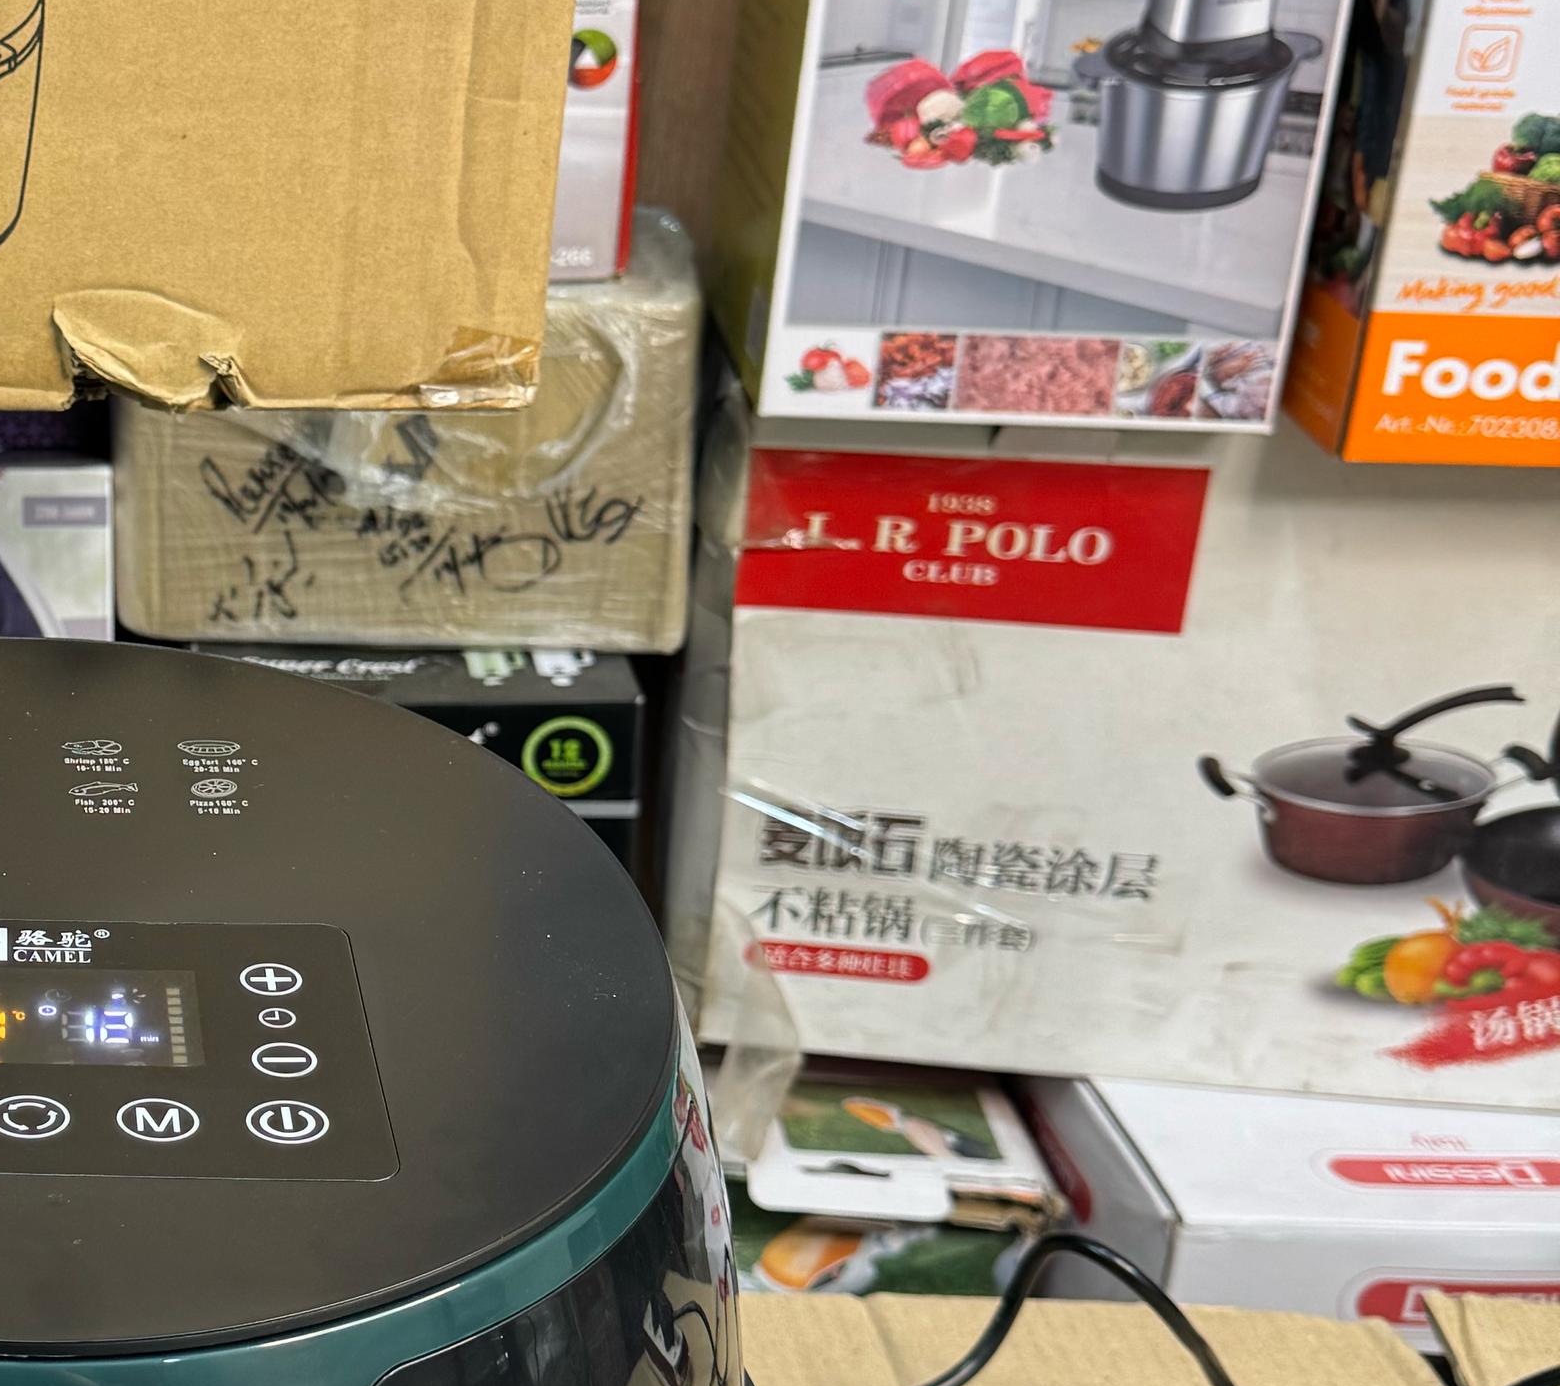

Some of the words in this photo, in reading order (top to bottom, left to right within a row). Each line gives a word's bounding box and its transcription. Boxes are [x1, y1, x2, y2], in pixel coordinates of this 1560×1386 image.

[1396, 277, 1485, 312] Making
[944, 518, 1114, 565] POLO
[902, 559, 1000, 586] CLUB
[15, 929, 92, 948] 骆驼
[13, 949, 92, 964] CAMEL
[140, 1033, 160, 1044] min
